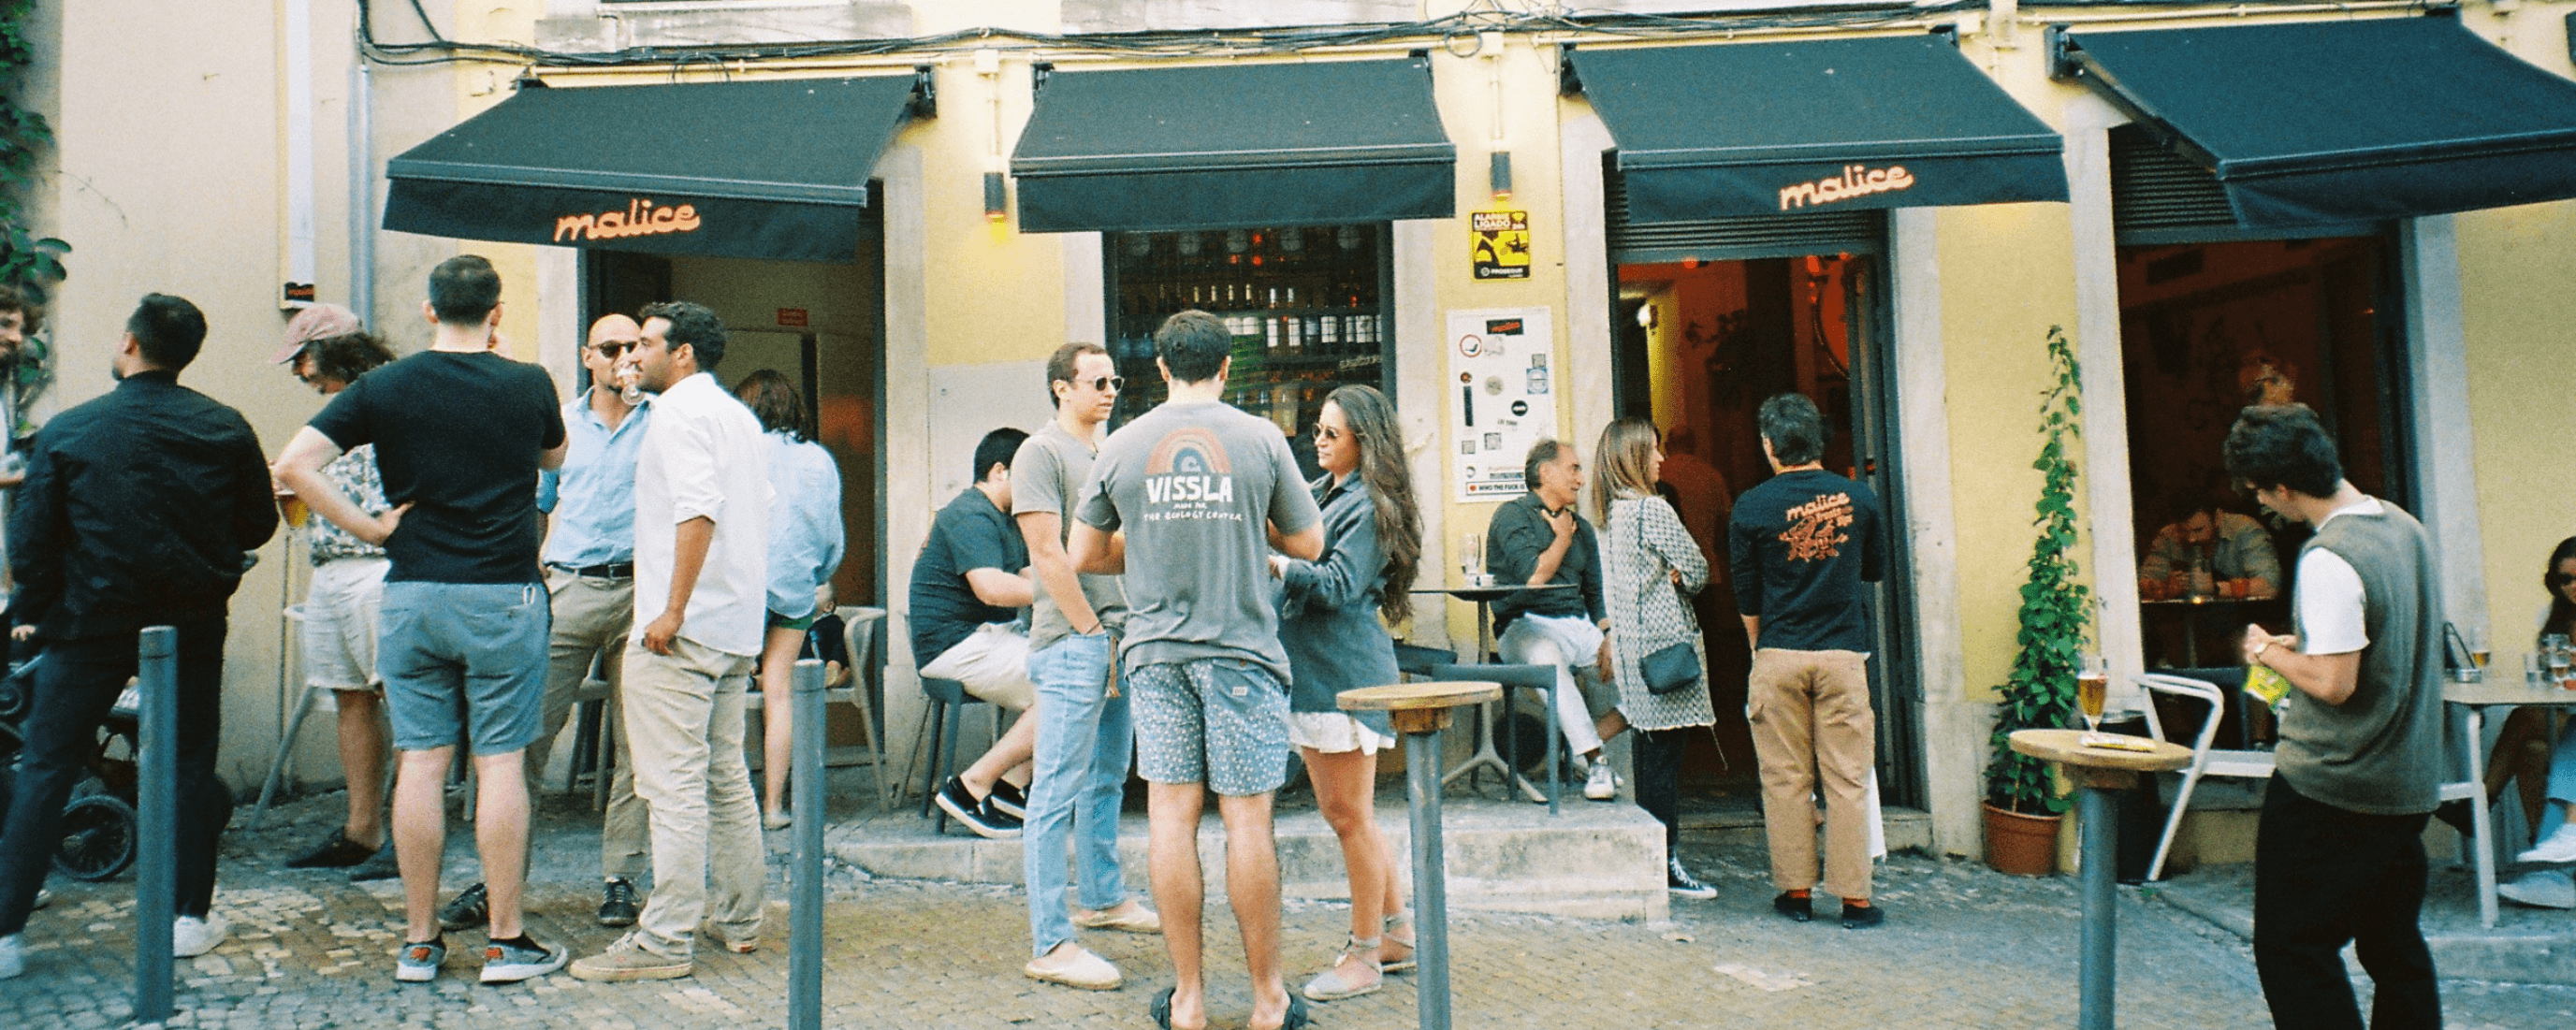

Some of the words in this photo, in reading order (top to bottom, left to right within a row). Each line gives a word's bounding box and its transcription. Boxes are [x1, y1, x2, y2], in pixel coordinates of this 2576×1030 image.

[1780, 164, 1914, 211] malice
[553, 197, 701, 243] malice
[1145, 475, 1233, 504] VISSLA
[1786, 491, 1851, 522] malice
